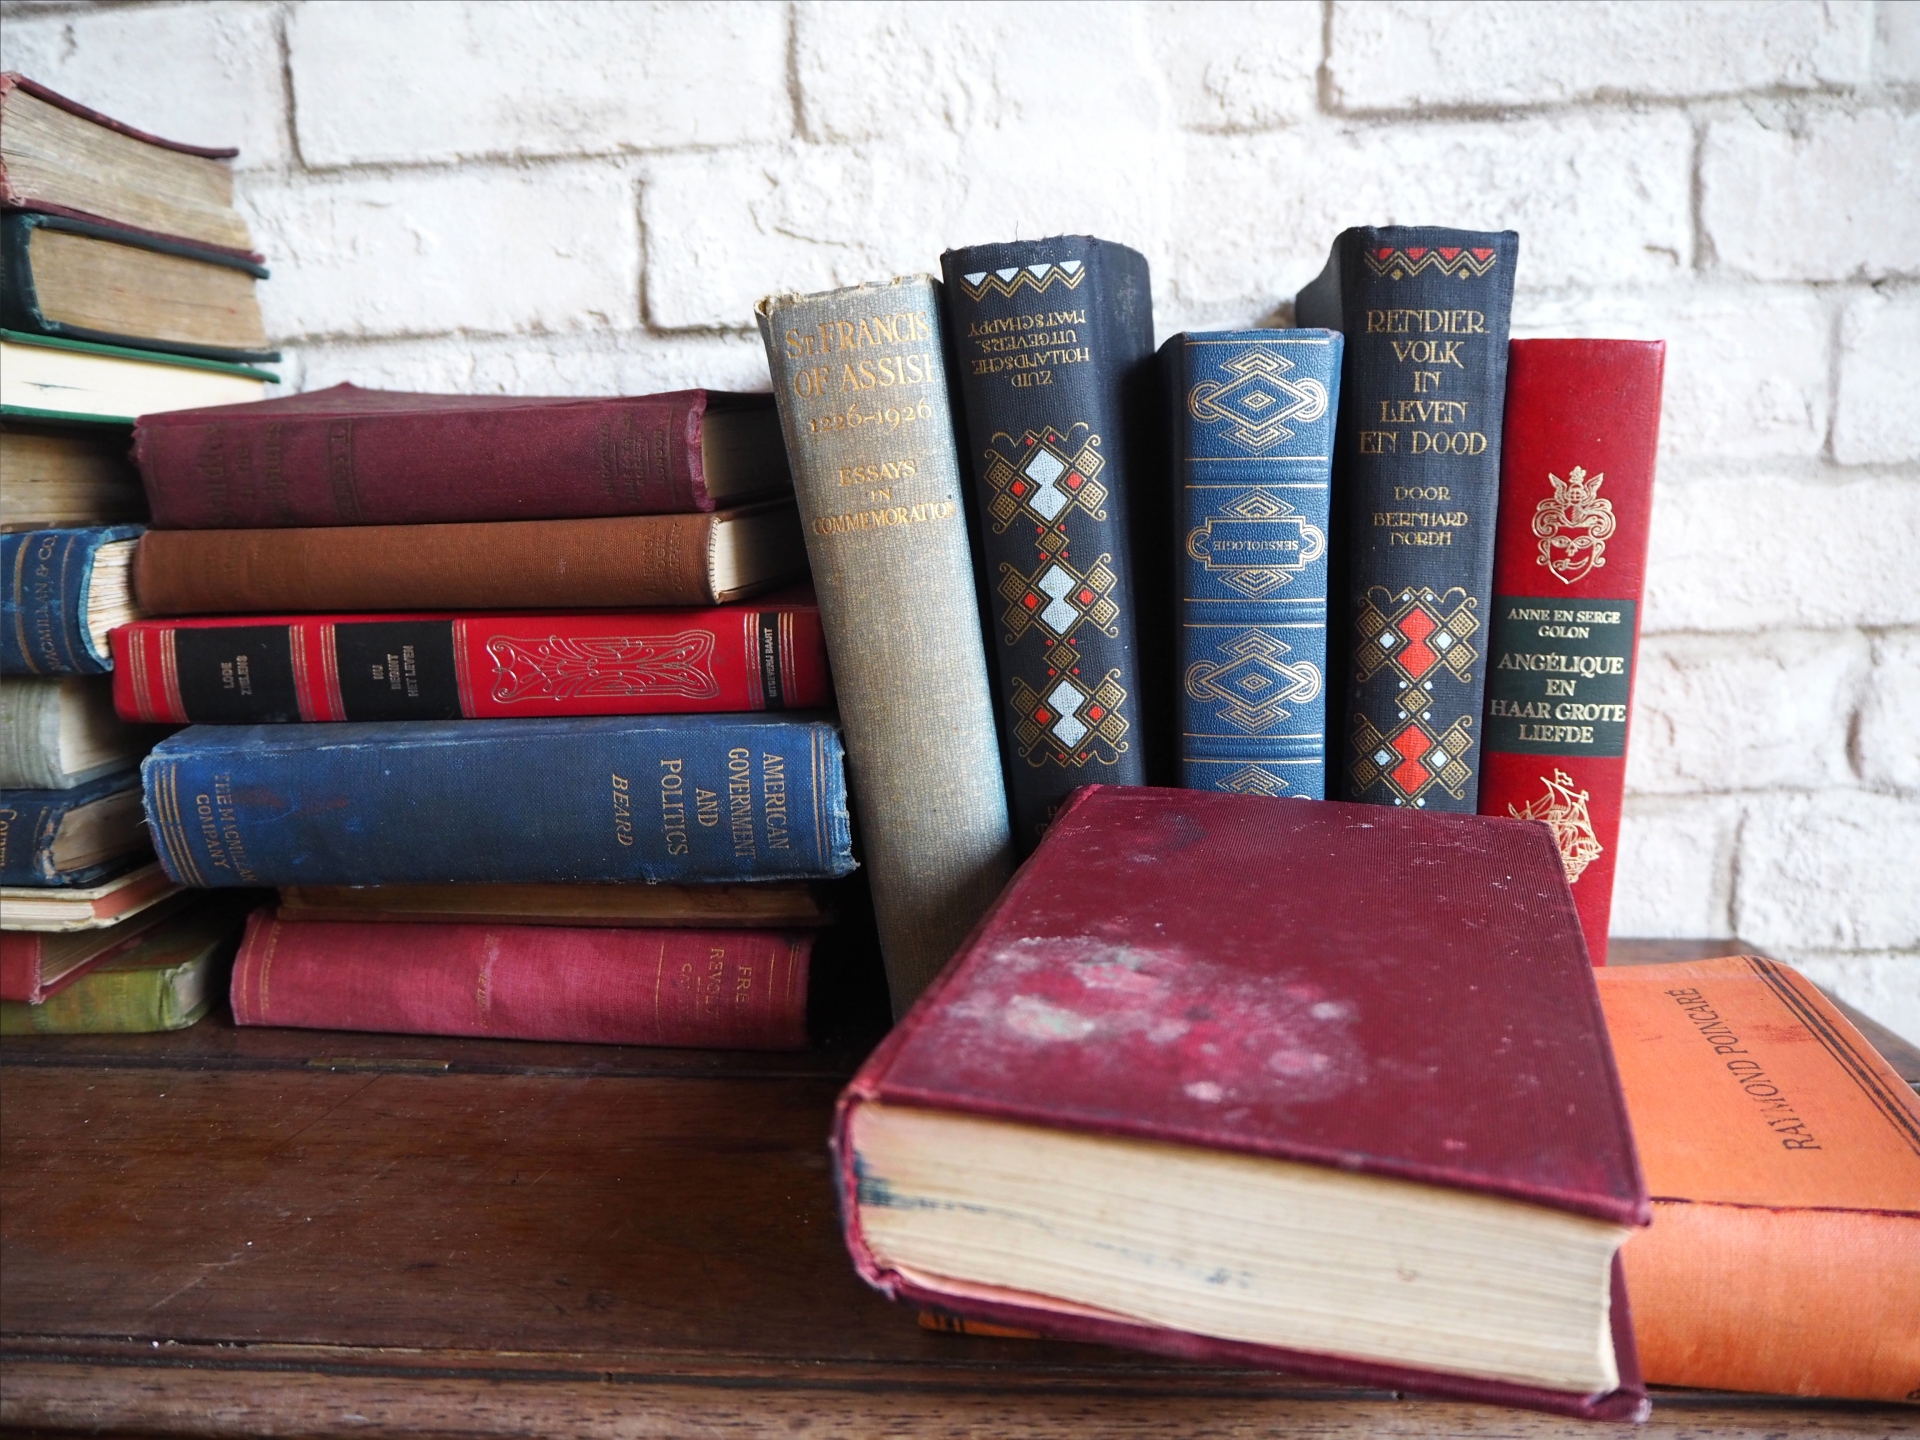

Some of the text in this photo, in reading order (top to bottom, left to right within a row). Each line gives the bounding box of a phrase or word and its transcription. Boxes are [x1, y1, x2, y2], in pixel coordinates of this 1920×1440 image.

[816, 311, 930, 354] FRANCIS
[968, 310, 1087, 338] MAATSCHAPPY
[972, 347, 1090, 375] HOLLANDSCHE
[1391, 340, 1465, 369] VOLK
[793, 353, 935, 399] OF ASSISI
[1413, 371, 1443, 393] IN
[810, 397, 933, 433] 1226-1926
[1380, 400, 1469, 424] LEVEN
[1359, 431, 1488, 455] EN DOOD
[838, 459, 917, 488] ESSAYS
[870, 487, 893, 502] IN
[1394, 486, 1451, 501] DOOR
[814, 501, 957, 536] COMMEMORATION
[1373, 512, 1469, 527] BERNHARD
[1213, 540, 1299, 551] SEKSUOLOGIE
[1390, 531, 1452, 546] NORDH
[1507, 608, 1621, 624] ANNE EN SERGE
[1538, 625, 1590, 639] GOLON
[220, 661, 235, 689] LODE
[372, 664, 384, 680] NU
[402, 645, 419, 697] HET LEVEN
[1498, 652, 1624, 678] ANGÉLIQUE
[1545, 679, 1577, 696] EN
[1490, 699, 1627, 722] HAAR GROTE
[1518, 724, 1594, 743] LIEFDE
[612, 772, 634, 846] BEARD
[660, 758, 689, 856] POLITICS
[695, 787, 719, 827] AND
[728, 747, 756, 859] GOVERNMENT
[762, 751, 790, 850] AMERICAN
[196, 793, 231, 869] COMPANY
[214, 771, 258, 882] THE MACMILLAN
[1664, 987, 1823, 1151] RAYMOND POINCARÉ
